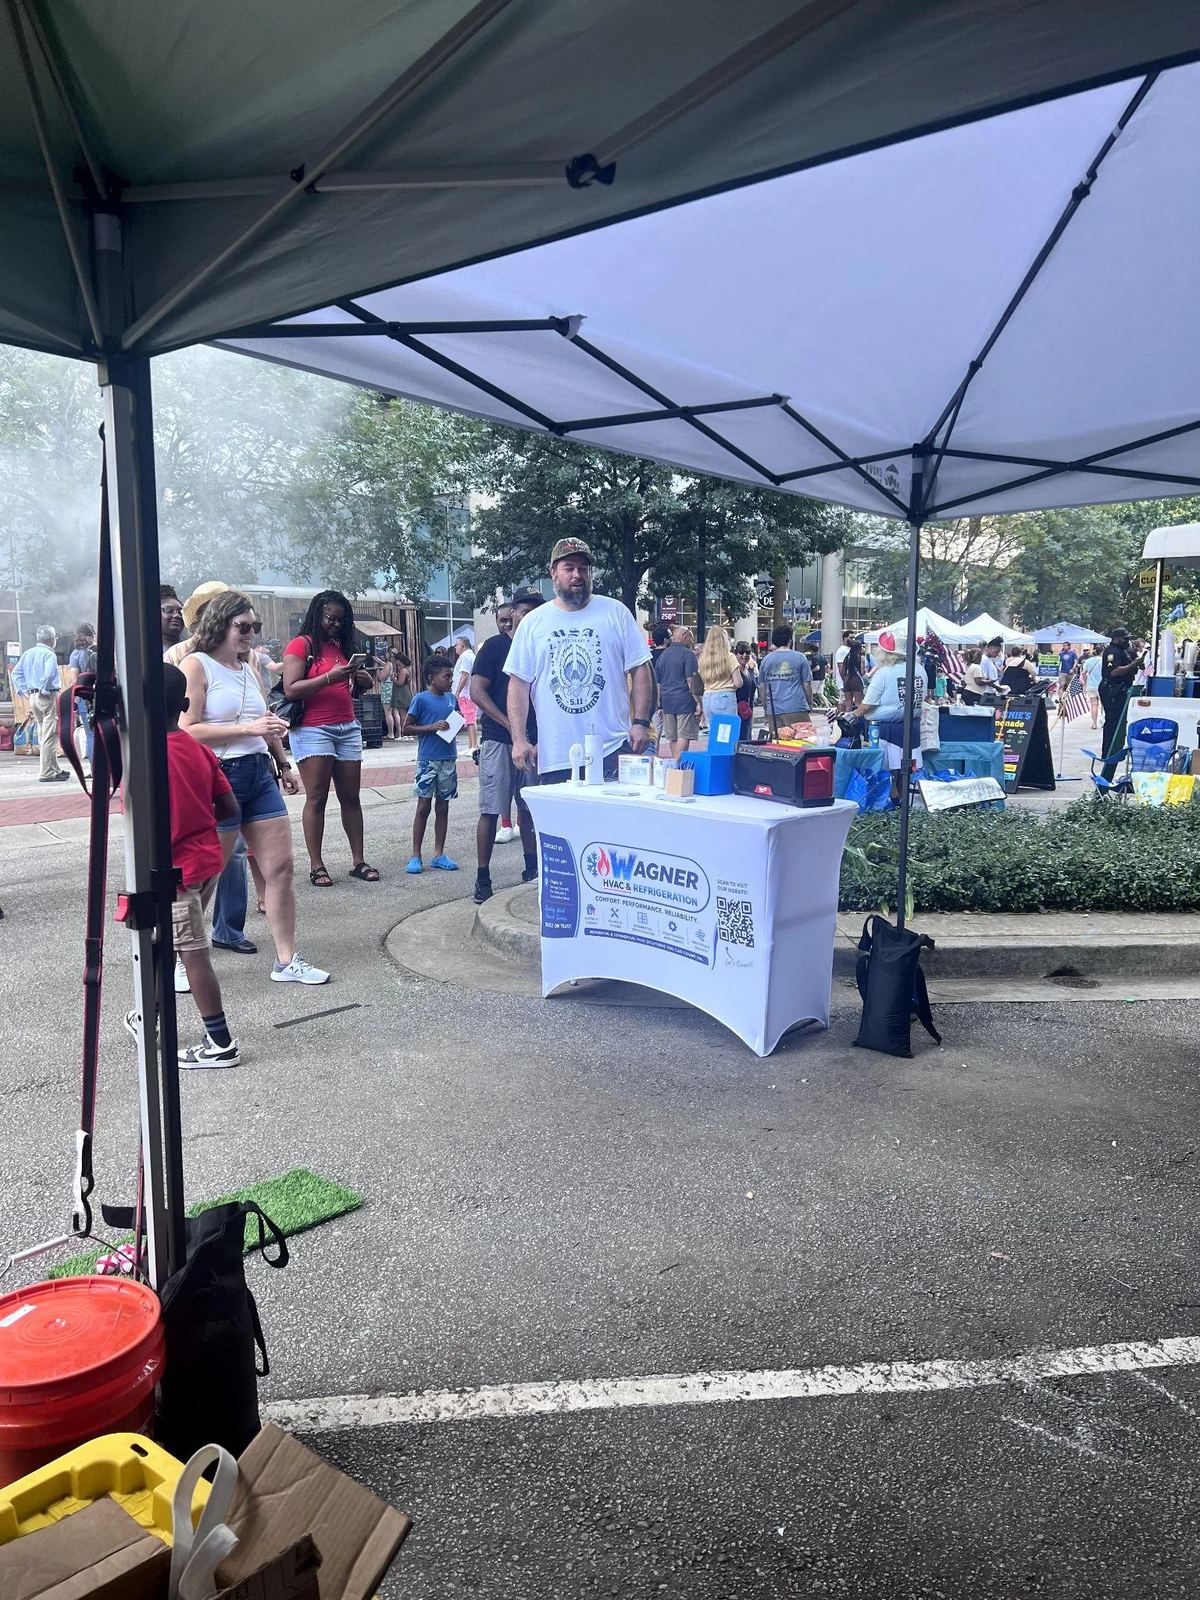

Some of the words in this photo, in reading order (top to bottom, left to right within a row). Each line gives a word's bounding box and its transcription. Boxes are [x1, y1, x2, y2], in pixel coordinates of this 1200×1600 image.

[1141, 575, 1170, 584] CLOD
[608, 848, 699, 891] WAGNER
[603, 878, 624, 890] HVAC
[626, 883, 632, 891] &
[633, 883, 698, 907] REFRIGERATION
